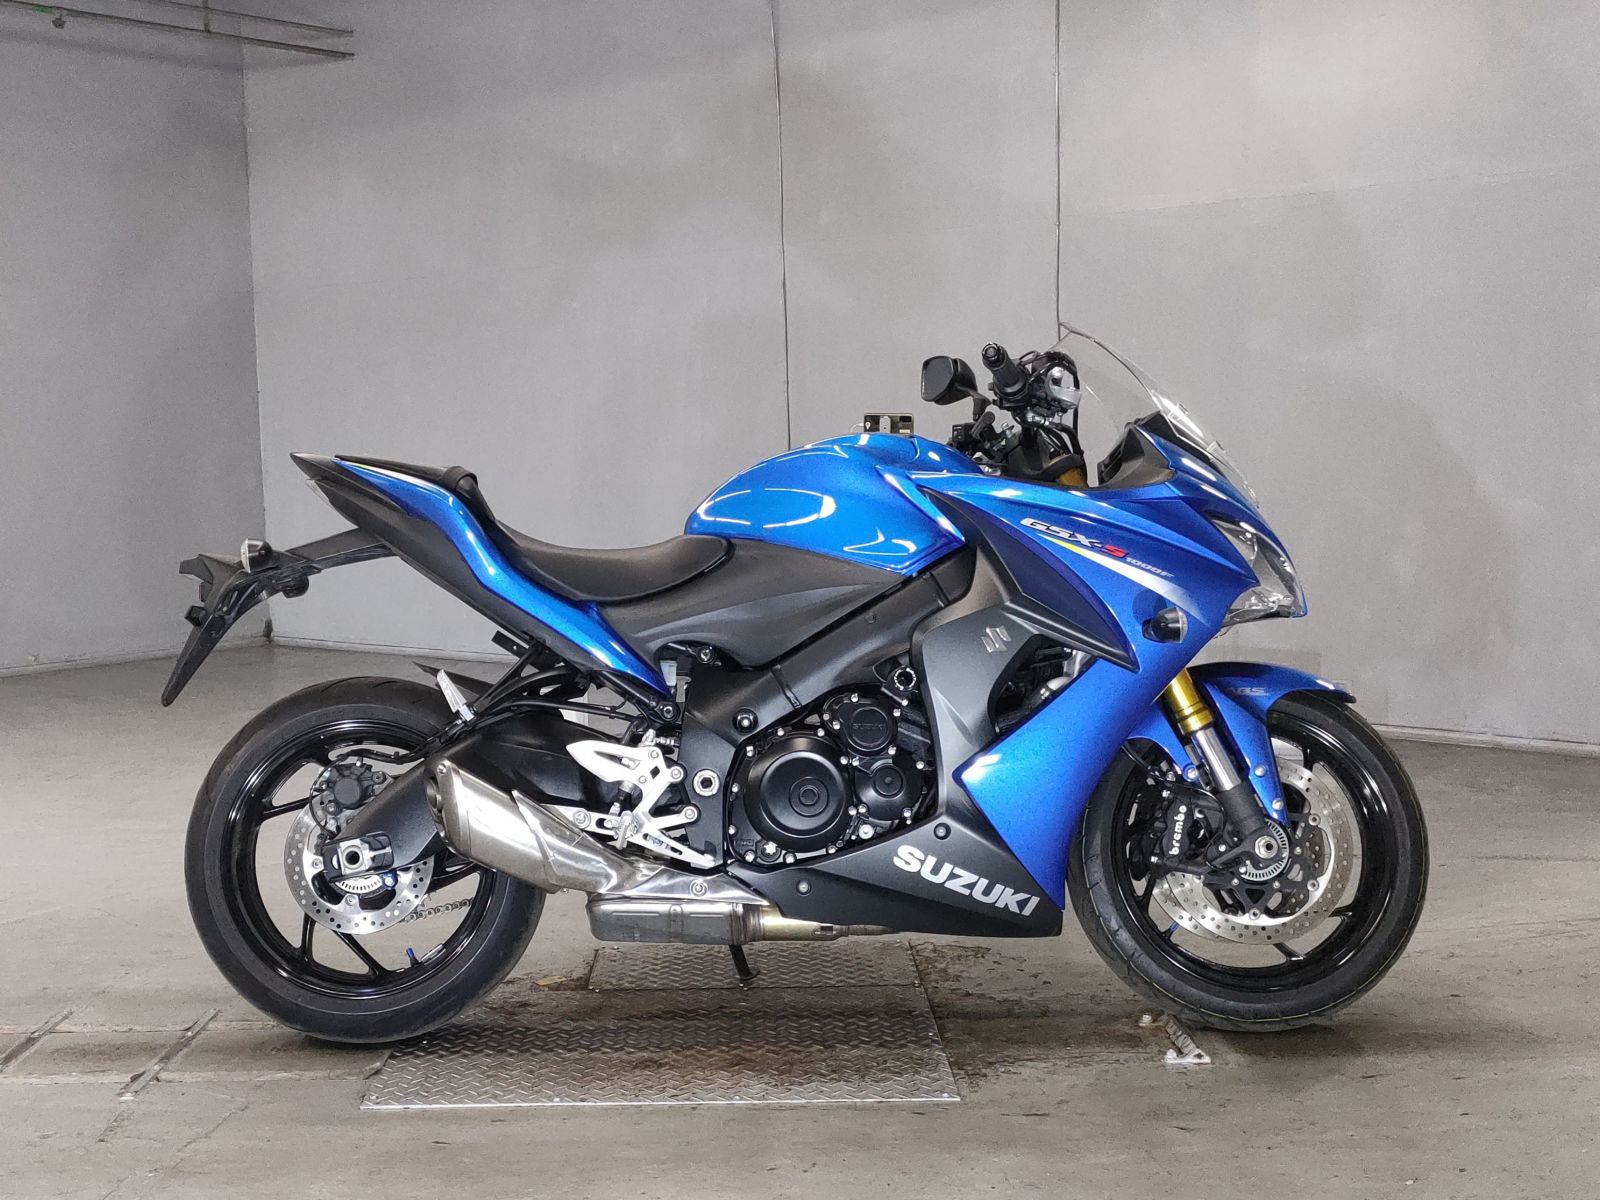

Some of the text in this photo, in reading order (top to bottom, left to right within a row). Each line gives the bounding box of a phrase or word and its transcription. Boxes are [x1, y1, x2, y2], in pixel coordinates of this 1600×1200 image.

[1020, 517, 1128, 558] GSX-S
[1168, 804, 1187, 855] brembo
[893, 845, 1040, 916] SUZUKI
